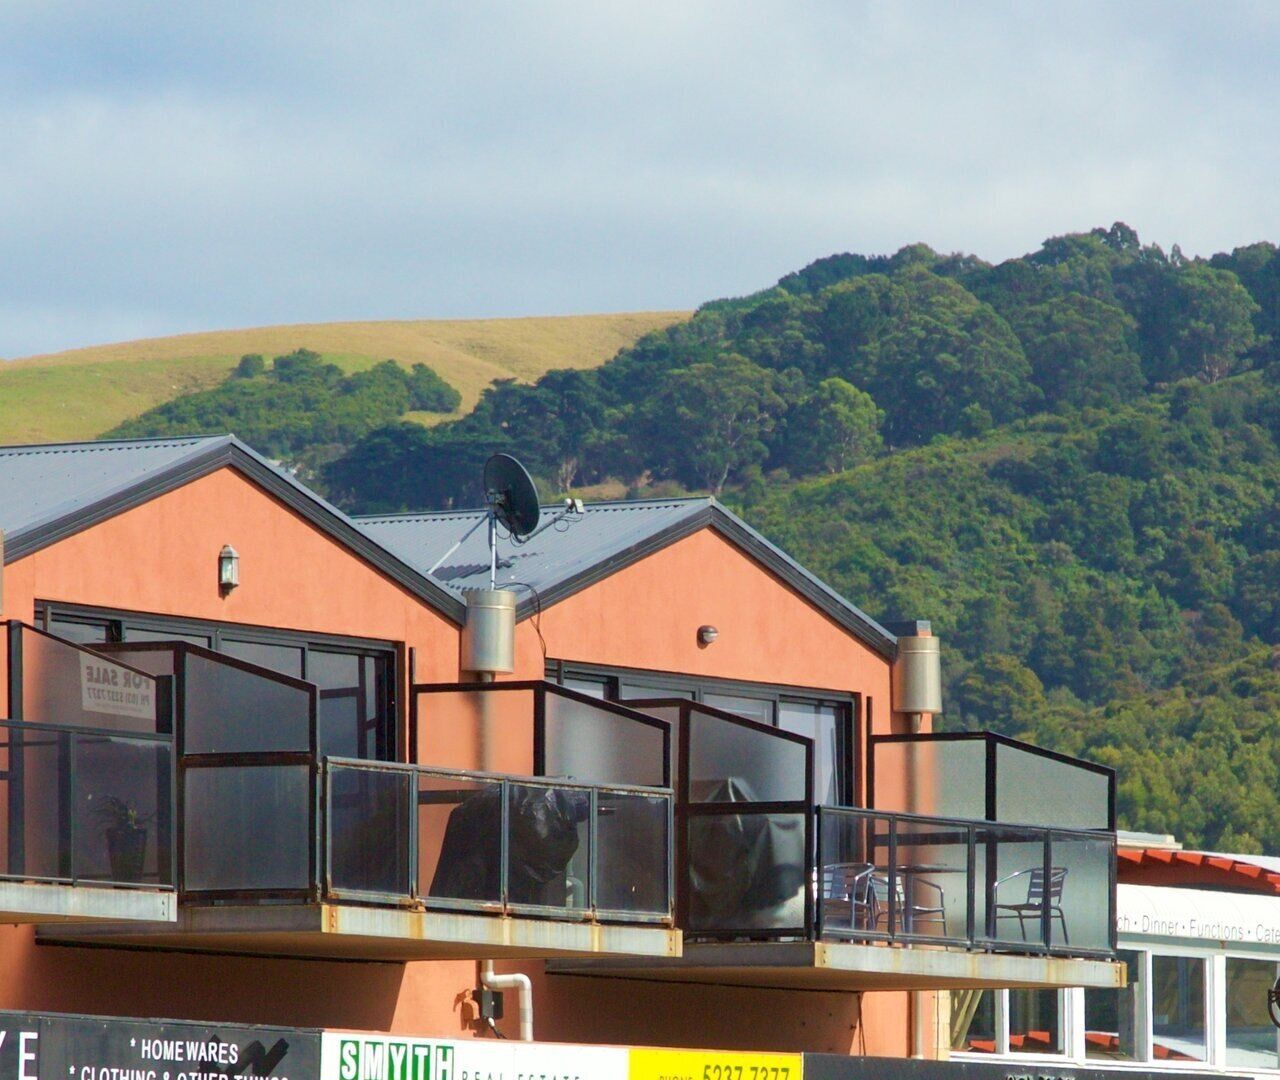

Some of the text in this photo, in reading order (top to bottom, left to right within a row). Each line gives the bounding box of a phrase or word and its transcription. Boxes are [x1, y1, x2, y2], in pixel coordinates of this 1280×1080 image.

[1142, 914, 1179, 936] Dinner
[1190, 918, 1244, 940] Functions
[141, 1039, 239, 1064] HOMEWARES
